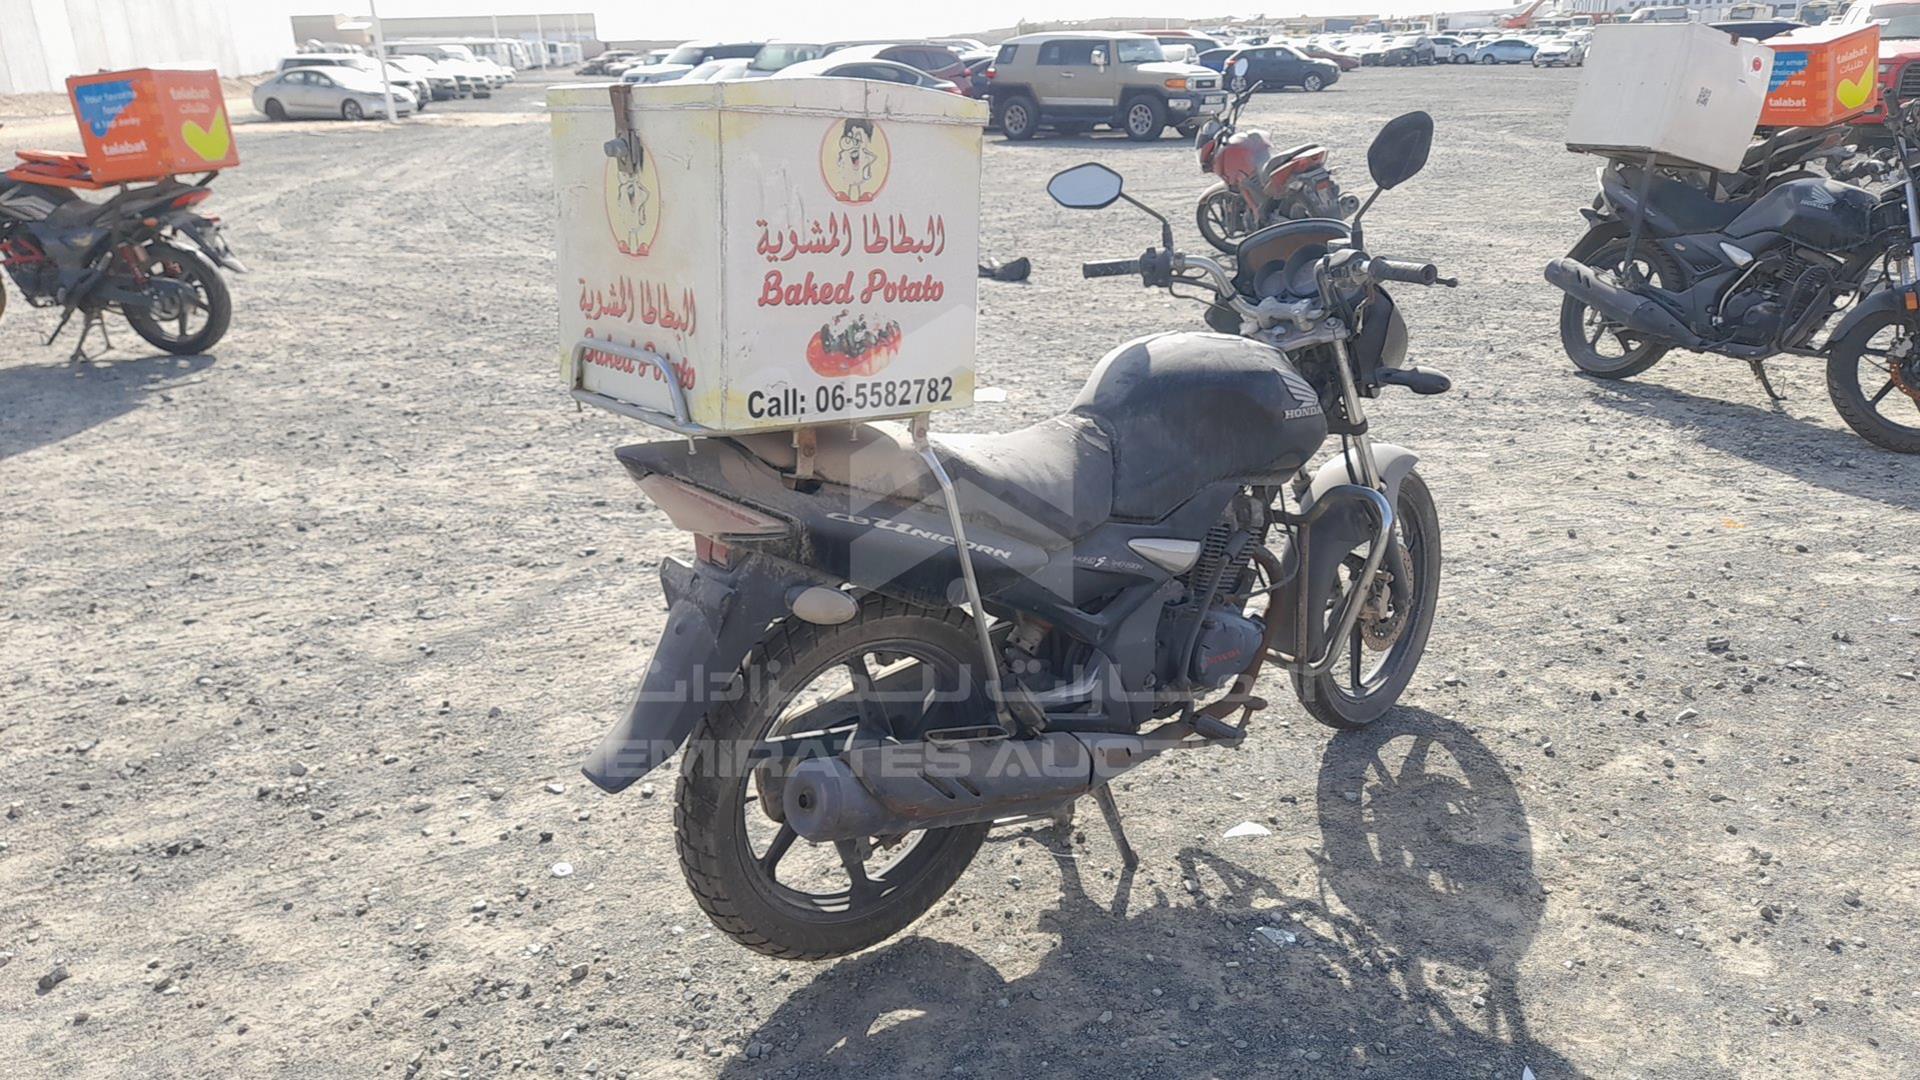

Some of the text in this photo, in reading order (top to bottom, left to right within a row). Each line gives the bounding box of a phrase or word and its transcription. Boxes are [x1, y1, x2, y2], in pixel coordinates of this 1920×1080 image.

[1836, 45, 1868, 64] talabat
[169, 87, 210, 100] talabat
[1769, 97, 1807, 107] talabat
[102, 140, 148, 155] talabat
[756, 212, 945, 262] البطاطا المشوية
[757, 268, 945, 307] Baked Potato
[578, 275, 696, 341] البطاطا المشوية
[748, 376, 953, 418] Call: 06-5582782
[1284, 406, 1323, 420] HONDA
